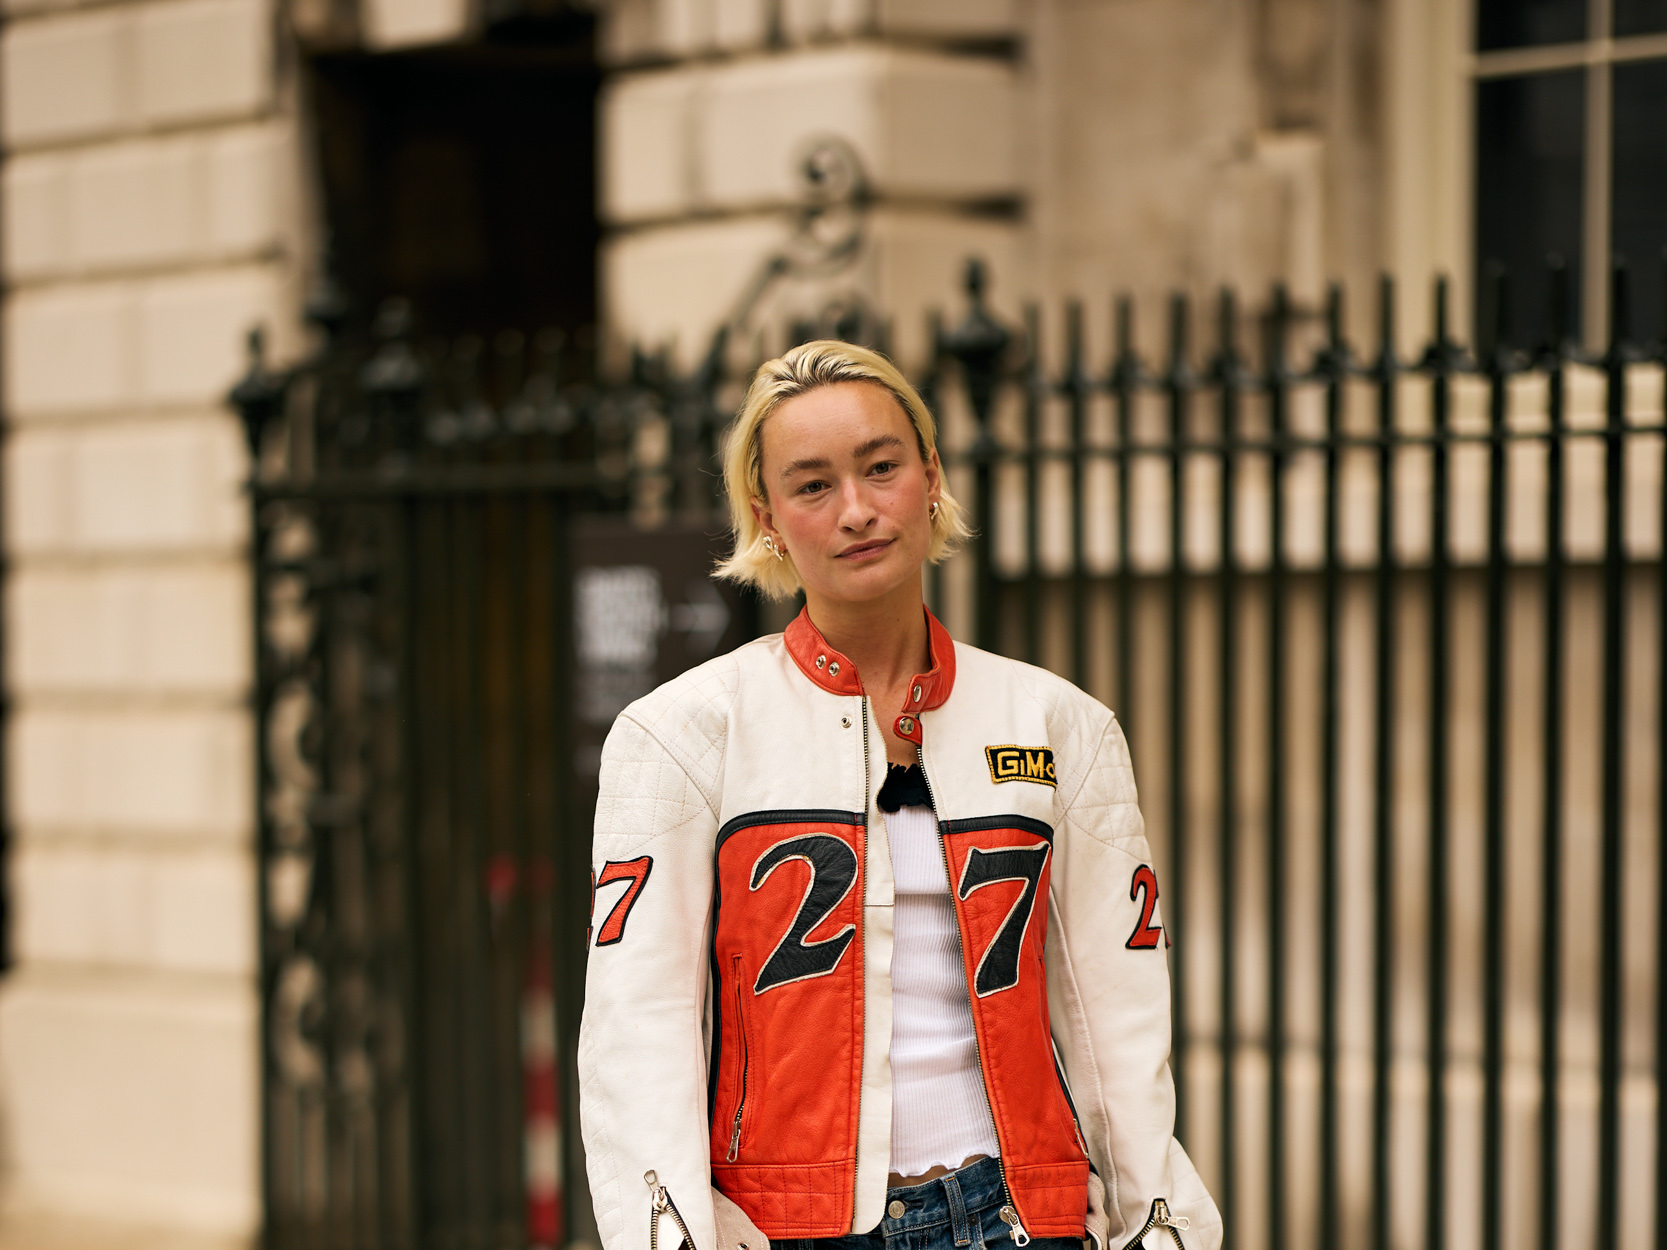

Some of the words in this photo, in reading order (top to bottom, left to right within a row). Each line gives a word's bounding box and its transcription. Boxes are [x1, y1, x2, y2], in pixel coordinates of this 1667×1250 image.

[586, 855, 654, 951] 7
[749, 832, 858, 996] 2
[957, 841, 1052, 998] 7
[1125, 863, 1172, 950] 2
